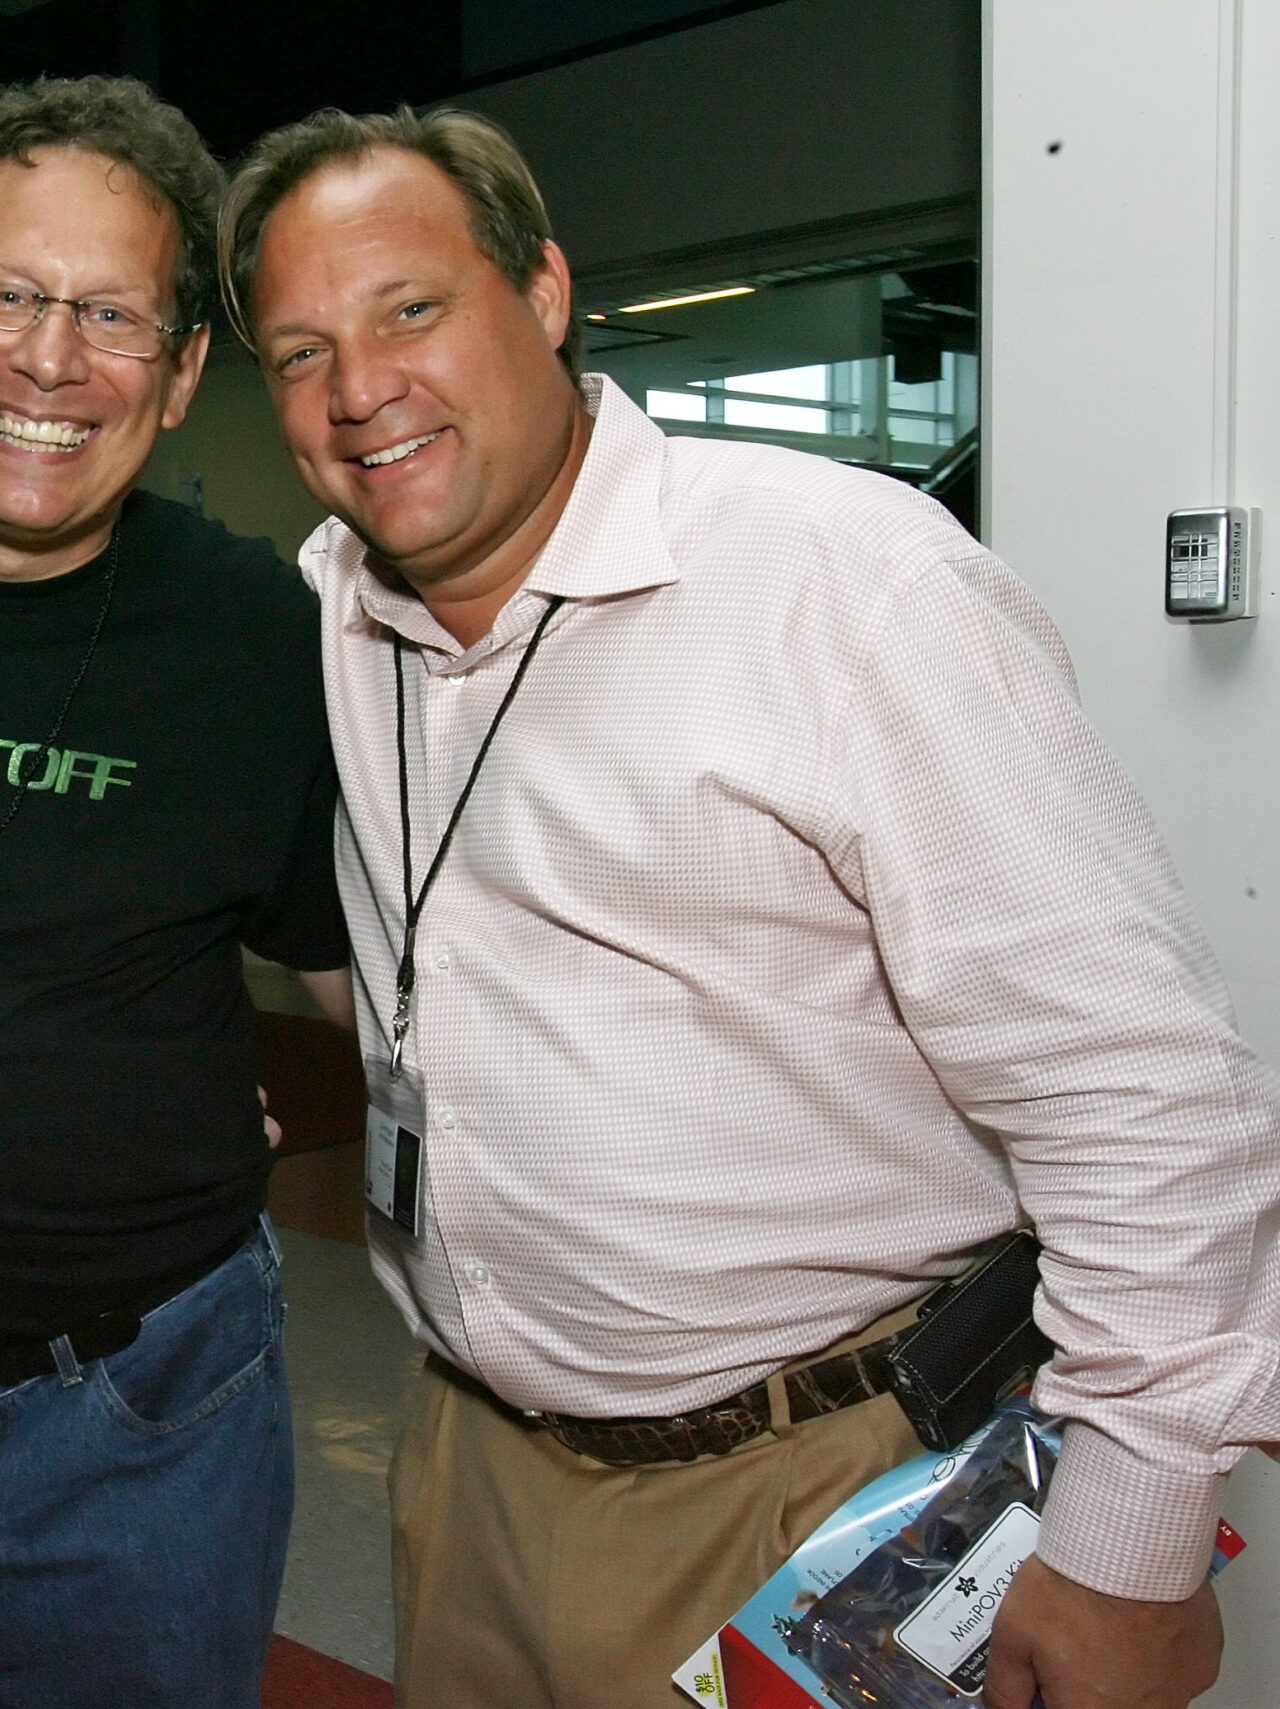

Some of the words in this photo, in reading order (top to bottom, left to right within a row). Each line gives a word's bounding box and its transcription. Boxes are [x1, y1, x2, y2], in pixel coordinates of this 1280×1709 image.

[950, 1577, 1010, 1643] MiniPOV3
[959, 1669, 970, 1677] To
[965, 1652, 985, 1670] build
[693, 1674, 706, 1693] $10
[702, 1672, 716, 1693] OFF
